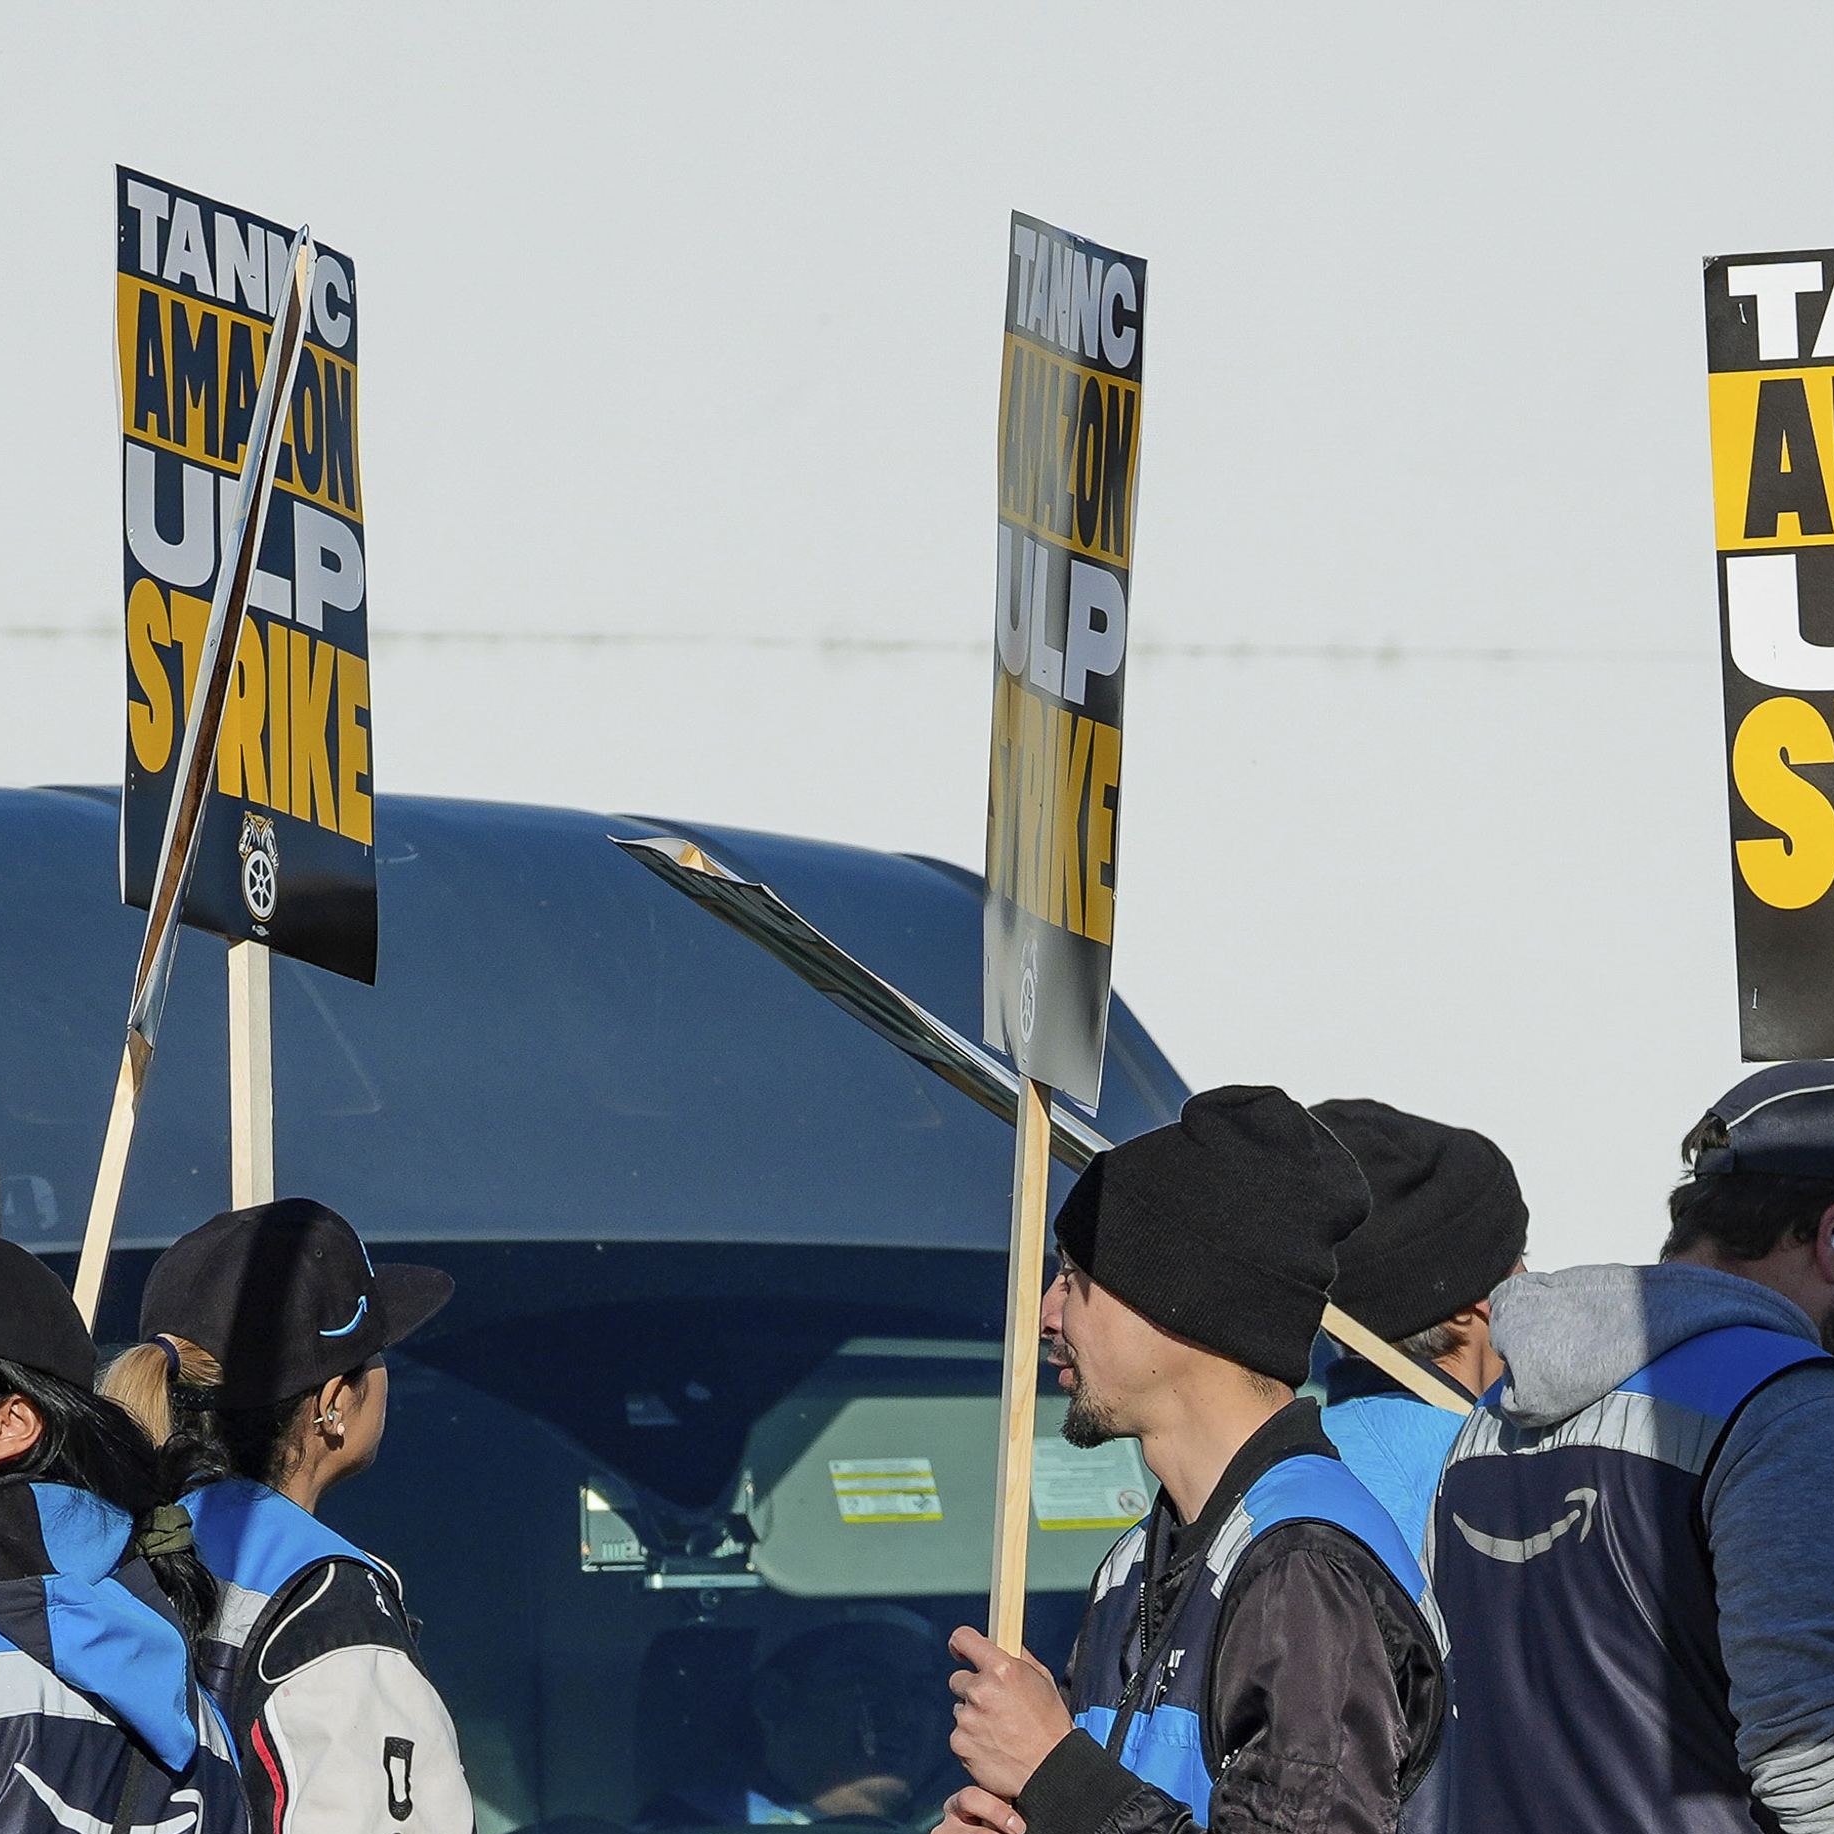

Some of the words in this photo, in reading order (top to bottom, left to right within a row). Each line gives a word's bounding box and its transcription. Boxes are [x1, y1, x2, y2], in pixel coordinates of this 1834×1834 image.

[134, 288, 357, 513] AMAON
[1013, 232, 1136, 370] TANNC
[1002, 343, 1136, 559] AMAZON
[996, 523, 1125, 706] ULP
[987, 670, 1122, 947] STRIKE
